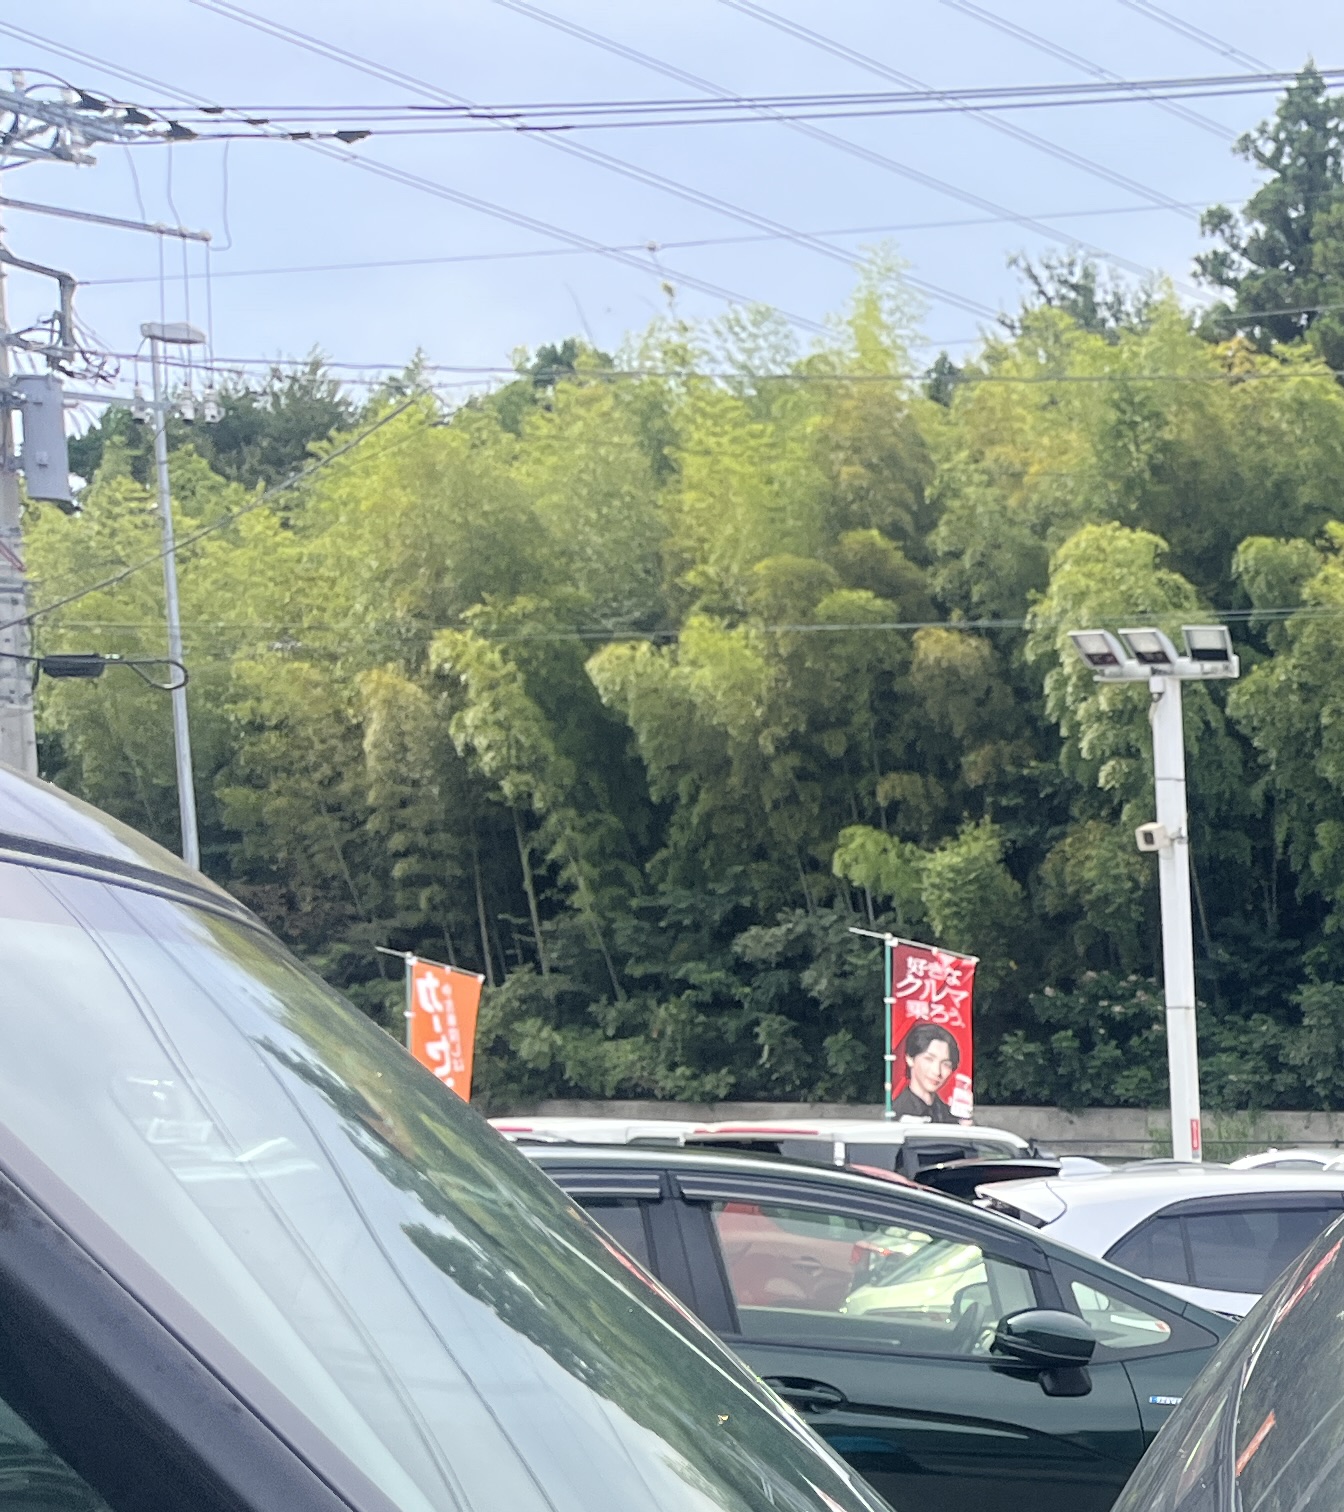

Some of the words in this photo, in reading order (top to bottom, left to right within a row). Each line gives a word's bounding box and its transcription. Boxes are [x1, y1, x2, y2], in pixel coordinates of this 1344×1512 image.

[907, 956, 962, 986] 好きな
[896, 975, 969, 1008] クルマ
